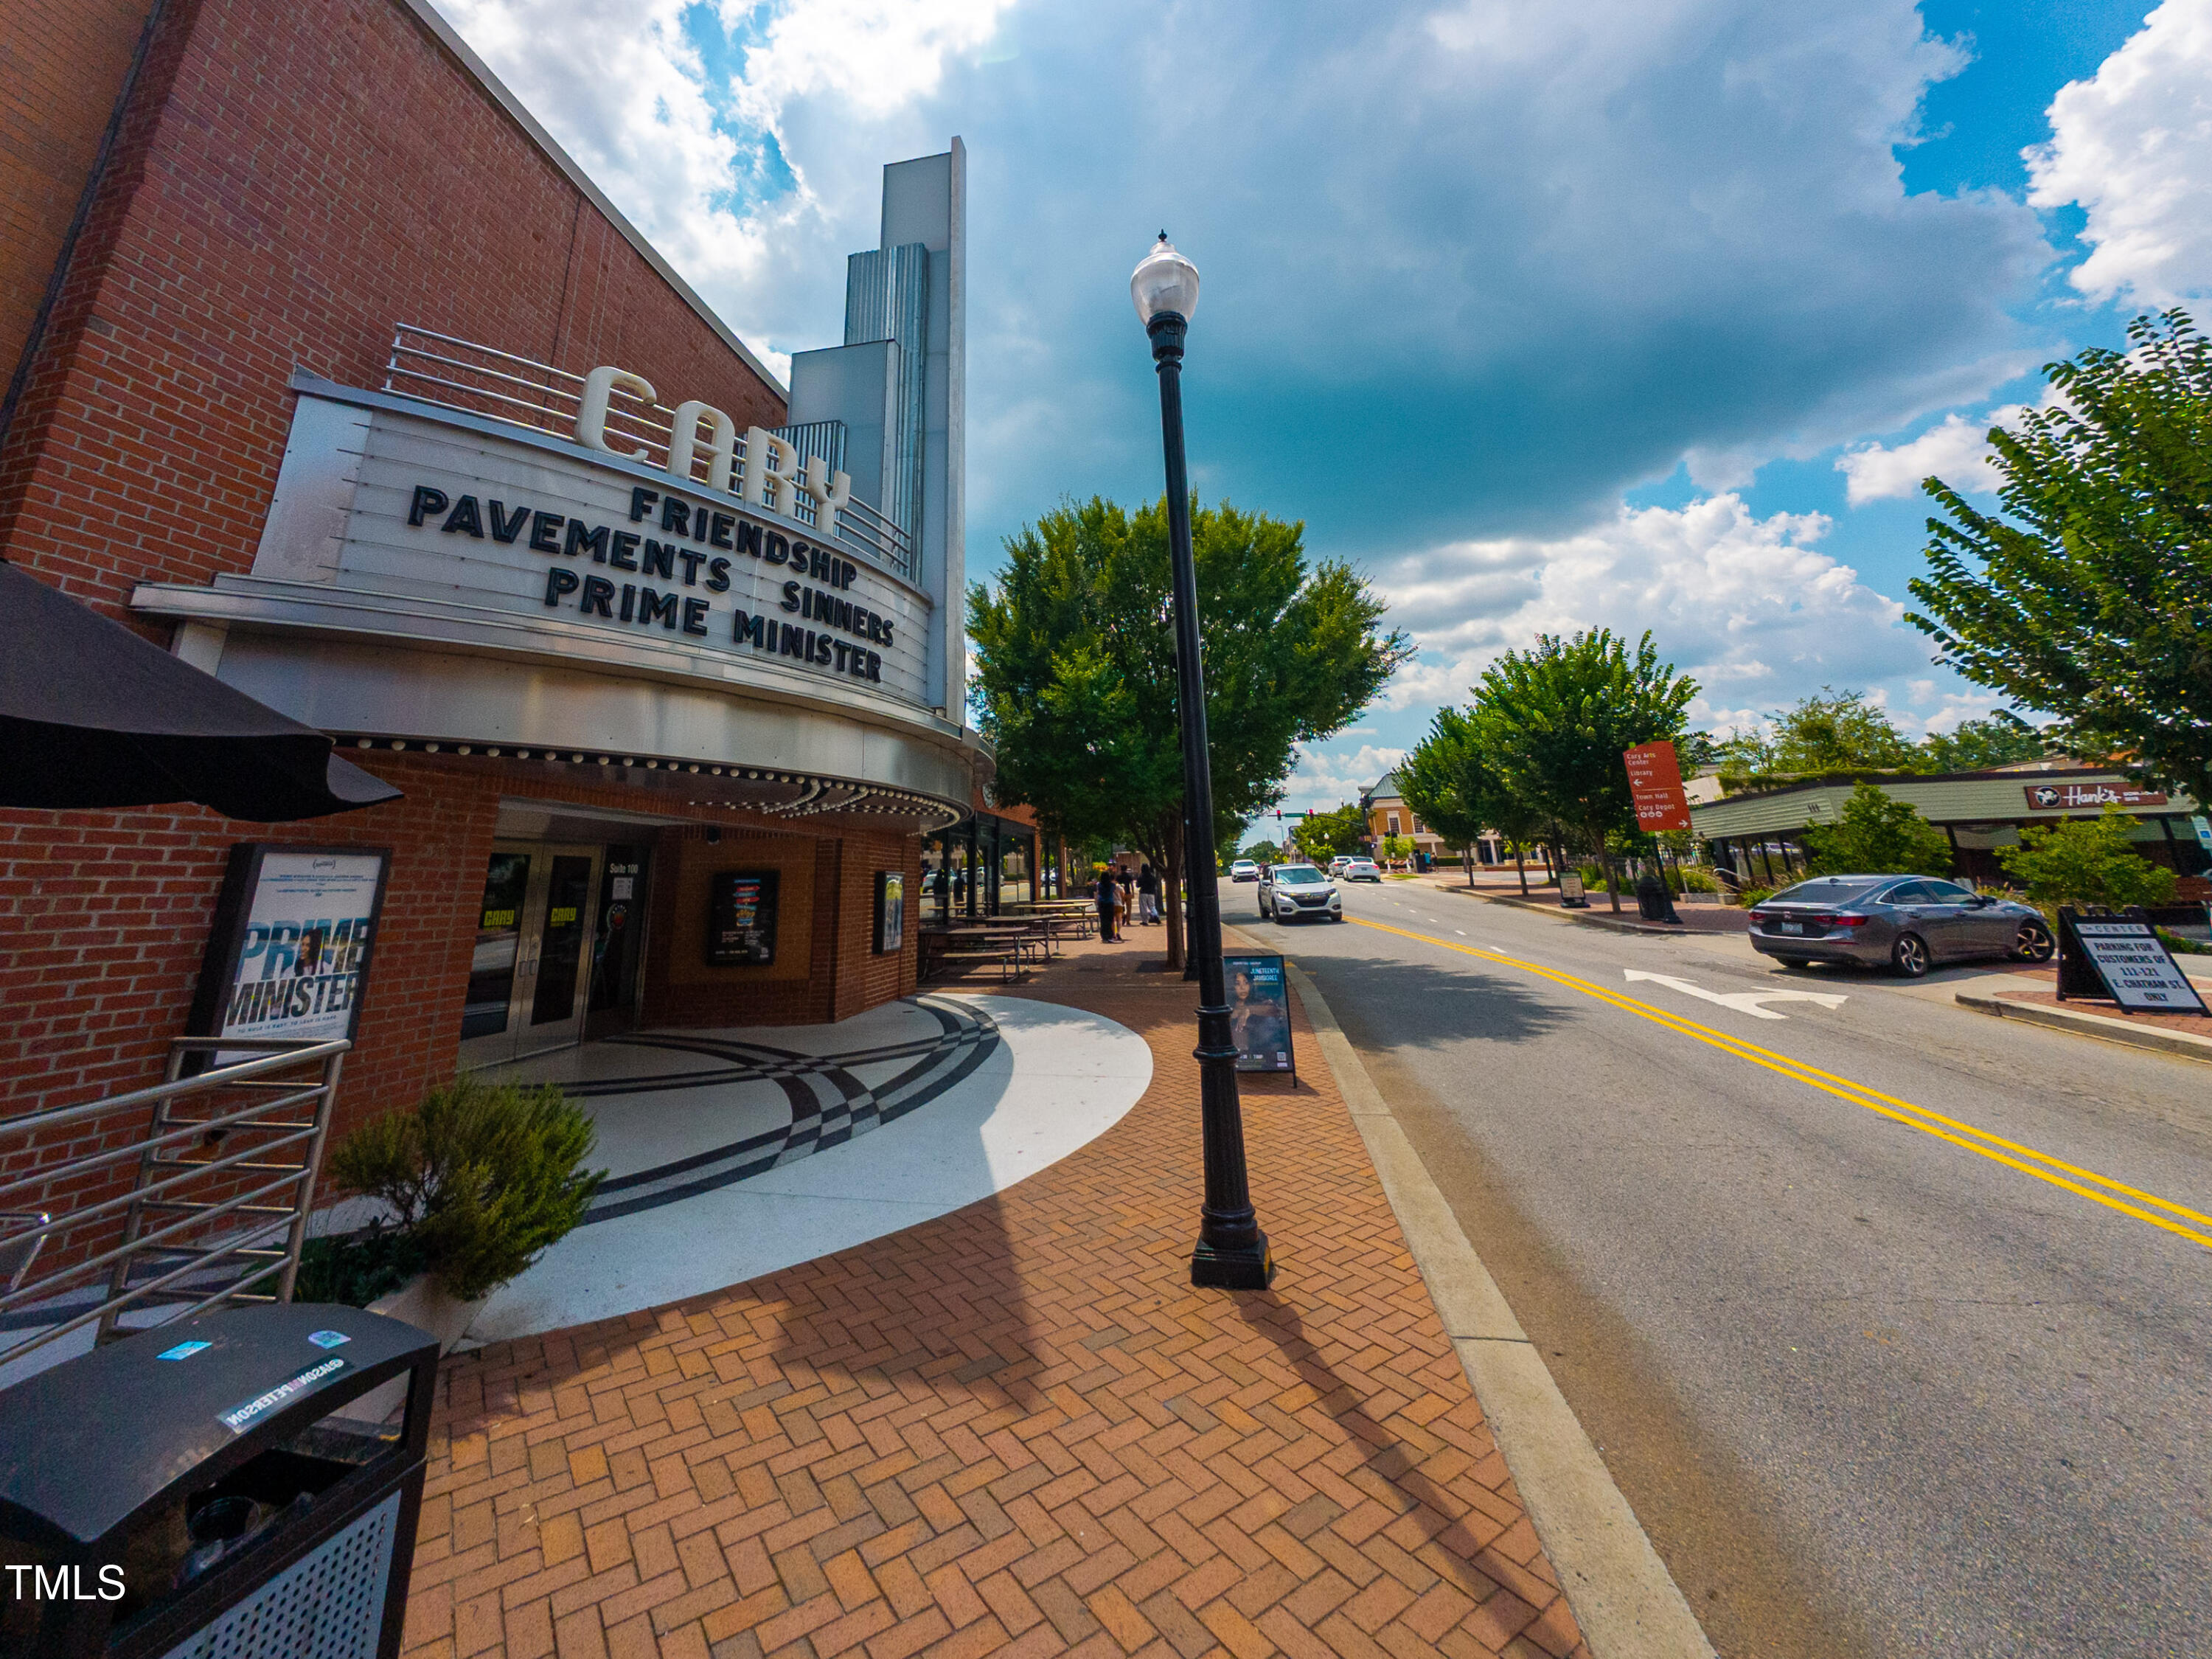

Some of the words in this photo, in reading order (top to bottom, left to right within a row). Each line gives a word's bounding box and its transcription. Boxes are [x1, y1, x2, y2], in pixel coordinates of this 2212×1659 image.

[576, 366, 851, 535] CARY
[406, 484, 731, 592] PAVEMENTS
[630, 486, 858, 591] FRIENDSHIP
[780, 580, 894, 648] SINNERS
[544, 566, 710, 637] PRIME
[734, 608, 883, 684] MINISTER
[2062, 785, 2122, 807] Hank's
[609, 863, 626, 874] Suite
[627, 863, 639, 874] 100
[484, 909, 515, 927] CARY
[550, 907, 577, 922] CARY
[2095, 925, 2146, 933] CENTER
[234, 917, 369, 984] PRIME
[2094, 942, 2134, 951] PARKING
[2134, 942, 2154, 951] FOR
[2096, 954, 2152, 964] CUSTOMERS
[2153, 955, 2166, 964] OF
[2120, 967, 2161, 976] 111-121
[2124, 979, 2169, 989] CHATHAM
[2168, 979, 2185, 990] ST.
[2143, 992, 2169, 1001] ONLY
